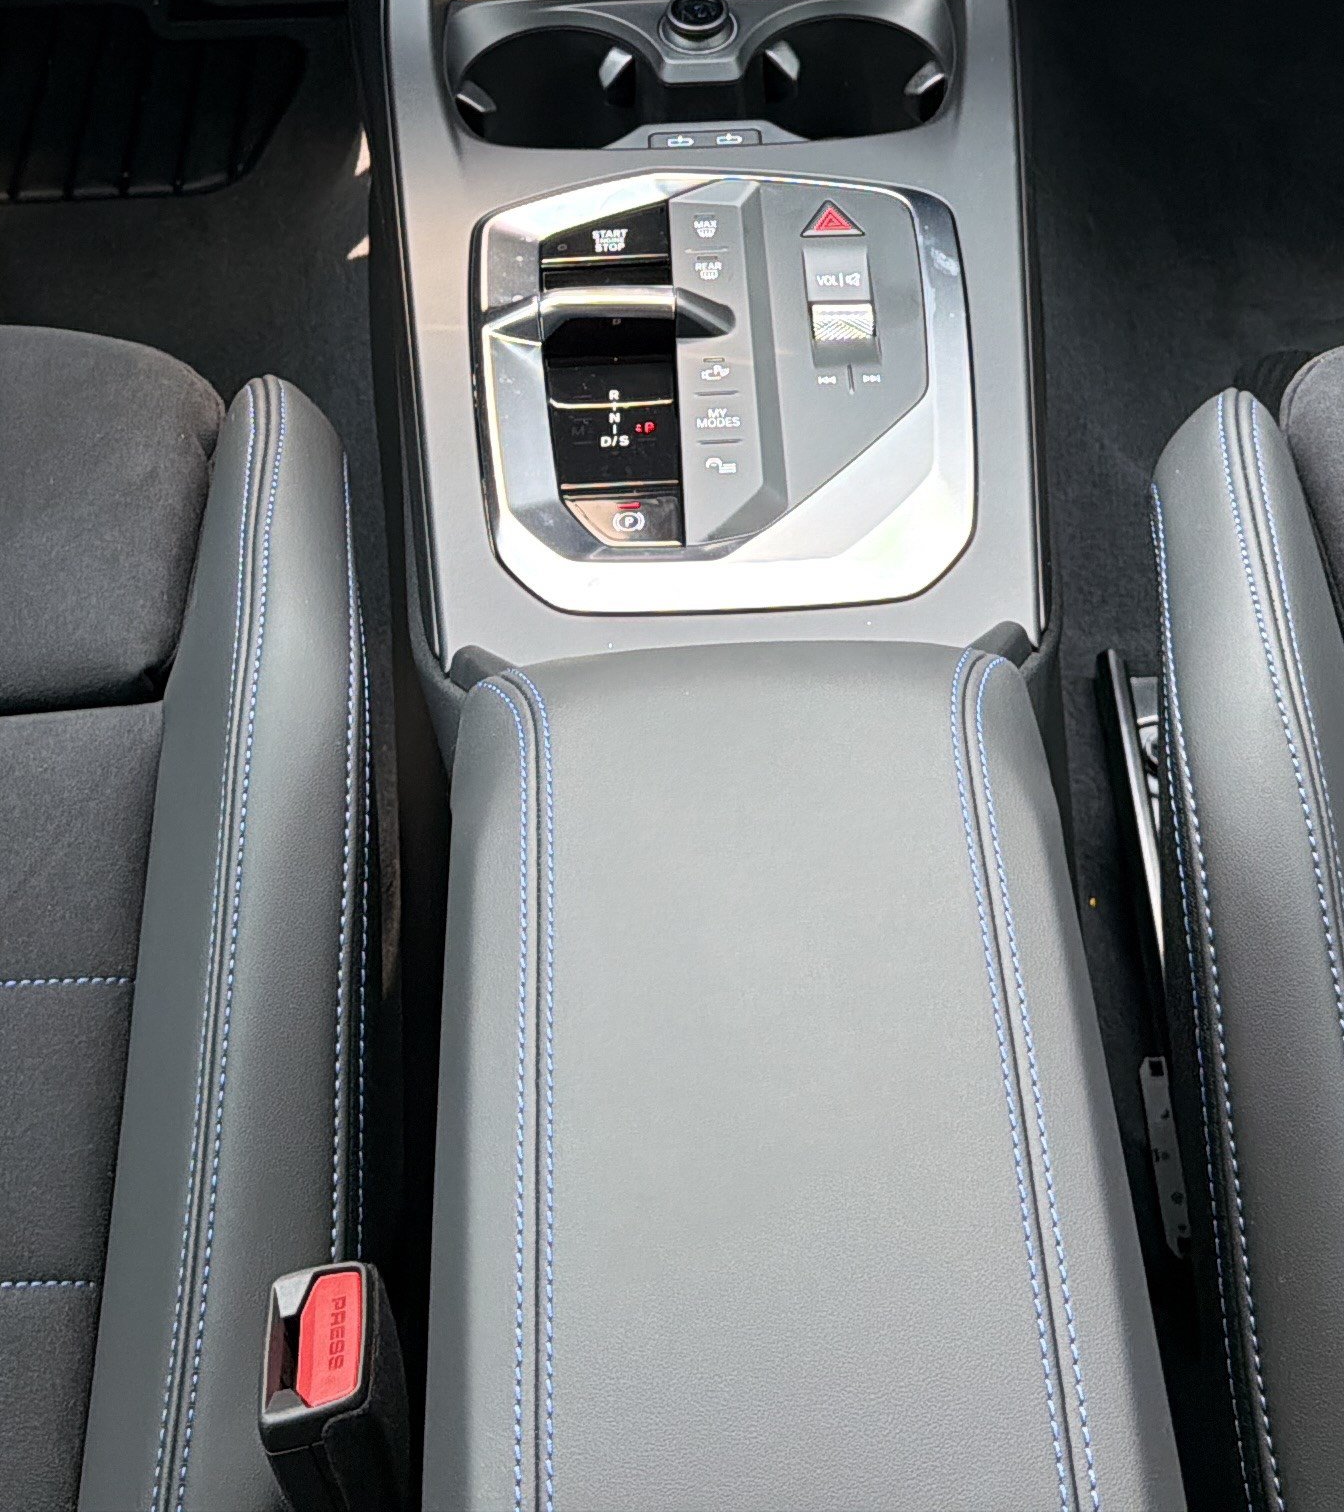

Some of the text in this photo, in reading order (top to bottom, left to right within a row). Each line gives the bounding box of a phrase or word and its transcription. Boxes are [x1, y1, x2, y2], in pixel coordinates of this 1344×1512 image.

[693, 219, 718, 229] MAX
[591, 228, 629, 240] START
[594, 242, 627, 253] STOP
[694, 261, 722, 271] REAR
[816, 274, 839, 286] VOL
[608, 389, 620, 400] R
[608, 412, 621, 423] N
[707, 408, 728, 419] MY
[696, 417, 741, 429] MODES
[600, 435, 630, 448] D/S
[328, 1294, 347, 1371] PRESS
